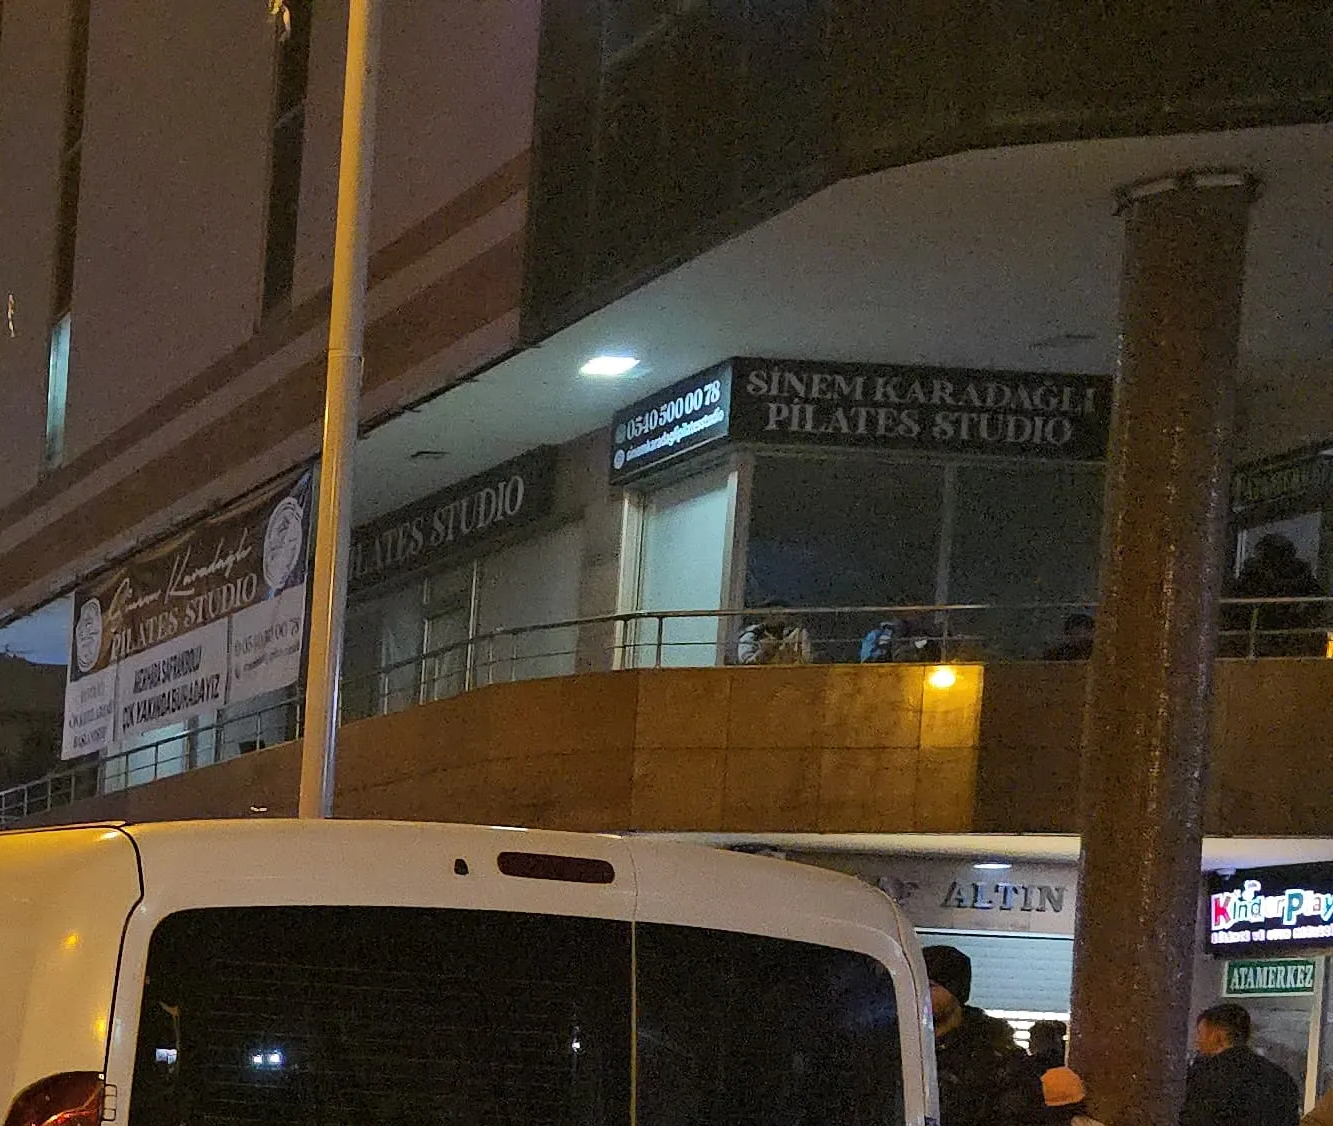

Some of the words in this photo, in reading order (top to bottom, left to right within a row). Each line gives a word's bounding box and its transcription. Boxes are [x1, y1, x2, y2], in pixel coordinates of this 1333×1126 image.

[746, 367, 864, 400] SİNEM
[626, 409, 658, 440] 0540
[658, 398, 684, 427] 500
[685, 388, 703, 415] 00
[704, 380, 721, 406] 78
[933, 412, 1074, 446] STUDIO
[431, 475, 525, 547] STUDIO
[183, 573, 257, 628] STUDIO
[939, 880, 1066, 913] ALTIN
